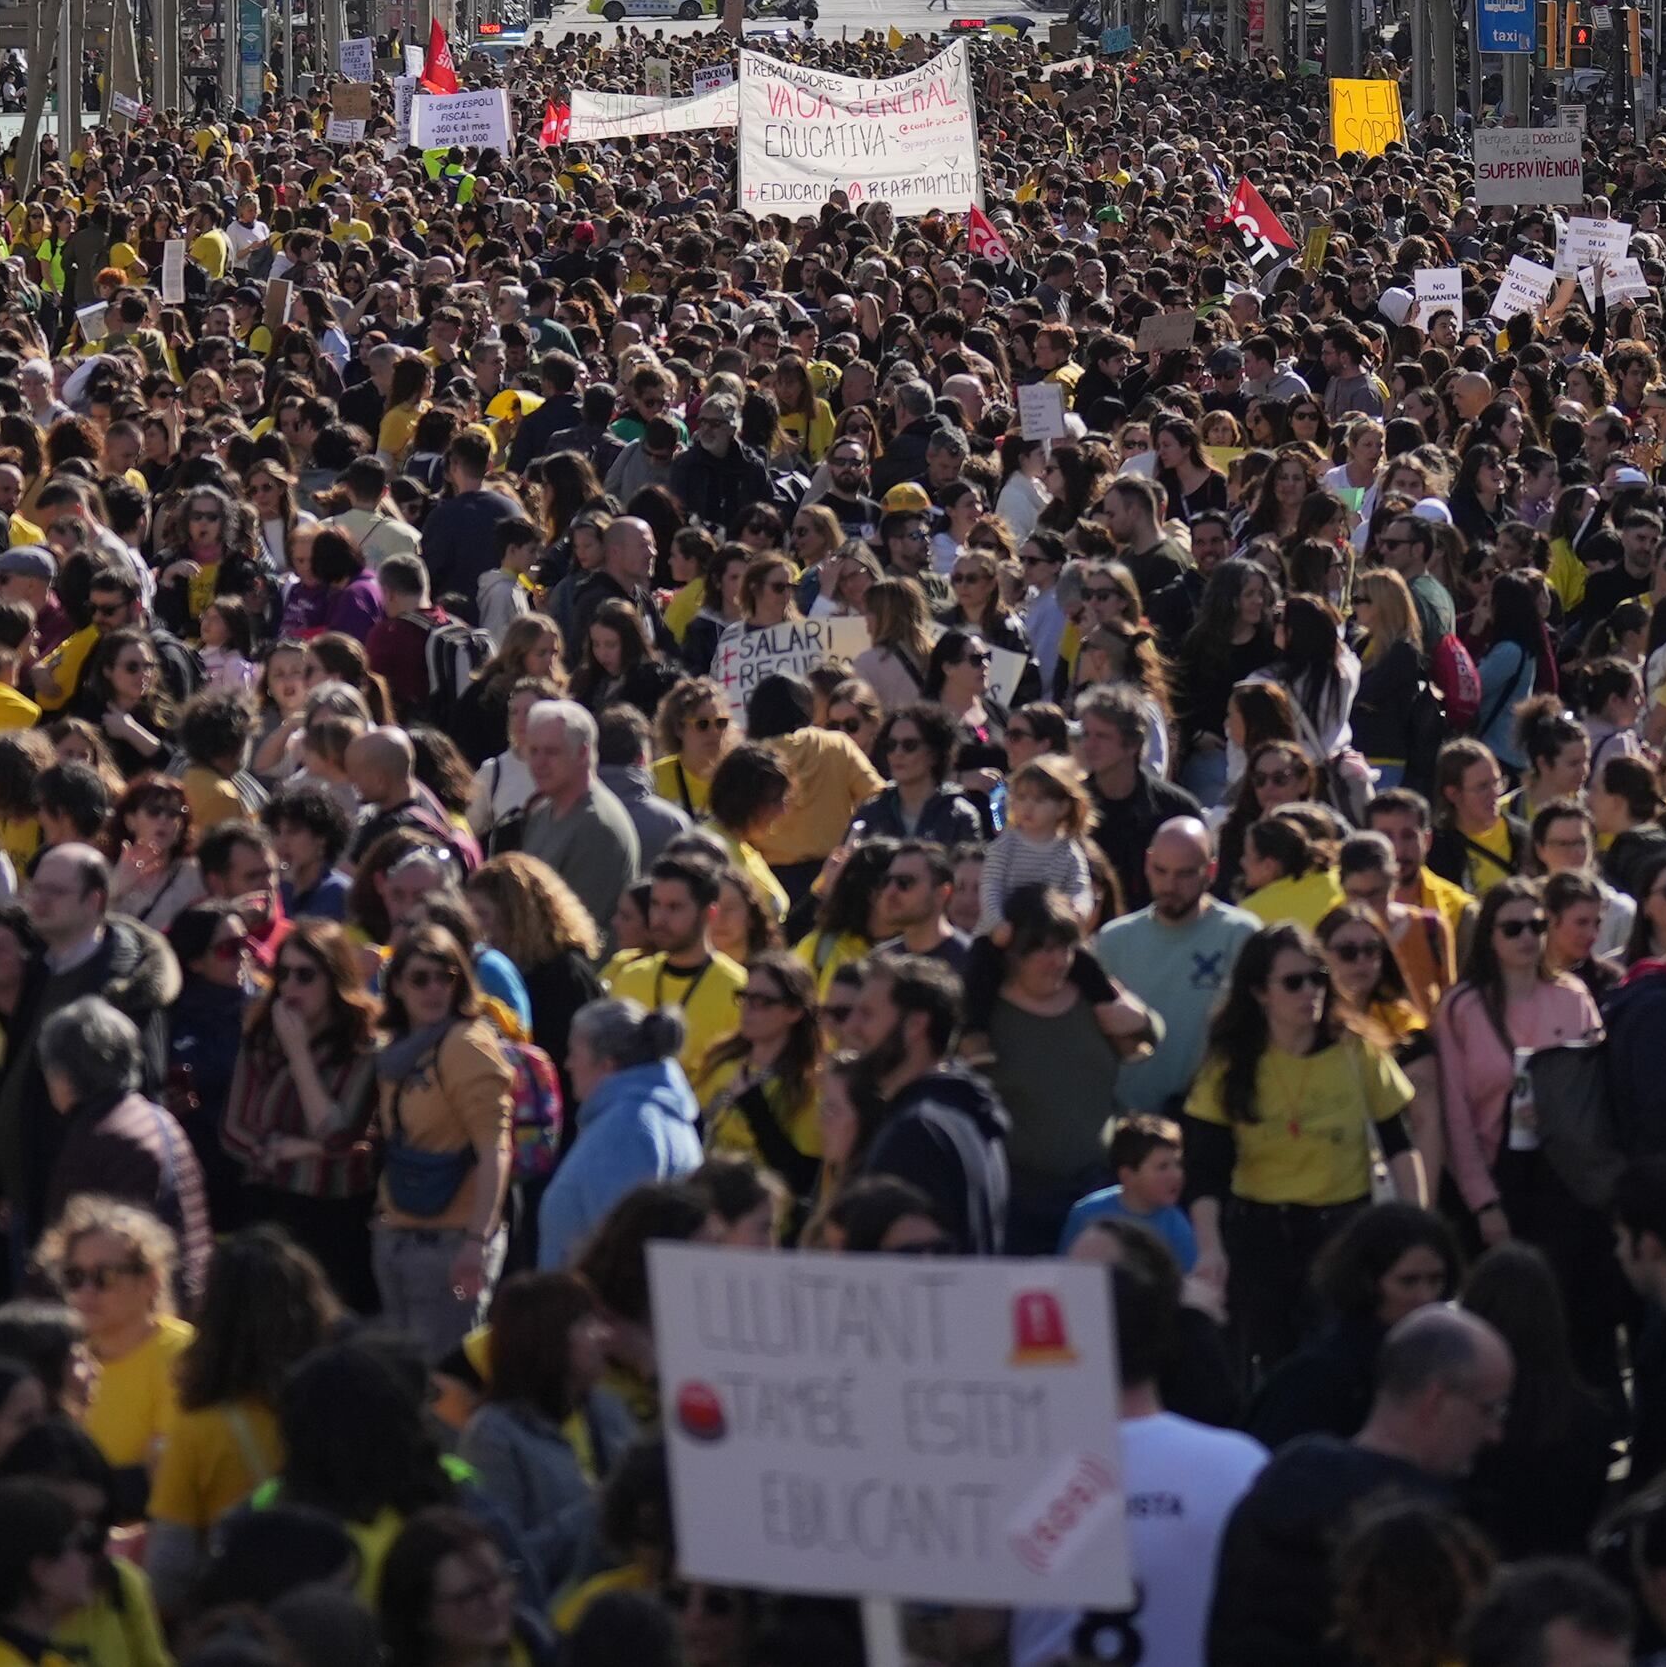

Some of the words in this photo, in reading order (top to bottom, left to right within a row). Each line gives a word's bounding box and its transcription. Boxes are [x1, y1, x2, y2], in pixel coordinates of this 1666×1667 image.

[1492, 29, 1517, 42] taxi
[705, 79, 721, 89] NO
[766, 83, 836, 120] VAGA
[846, 78, 957, 118] GENERAL
[428, 102, 434, 111] 5
[435, 102, 453, 111] dies
[440, 112, 472, 122] FISCAL
[453, 124, 460, 133] €
[461, 123, 470, 132] al
[471, 122, 492, 131] mes
[435, 137, 449, 147] per
[459, 133, 489, 143] 81.000
[765, 122, 887, 158] EDUCATIVA
[1592, 221, 1608, 230] SOU
[1588, 239, 1597, 247] DE
[1597, 240, 1607, 248] LA
[1432, 283, 1446, 291] NO
[759, 1469, 1000, 1562] EDUCANT
